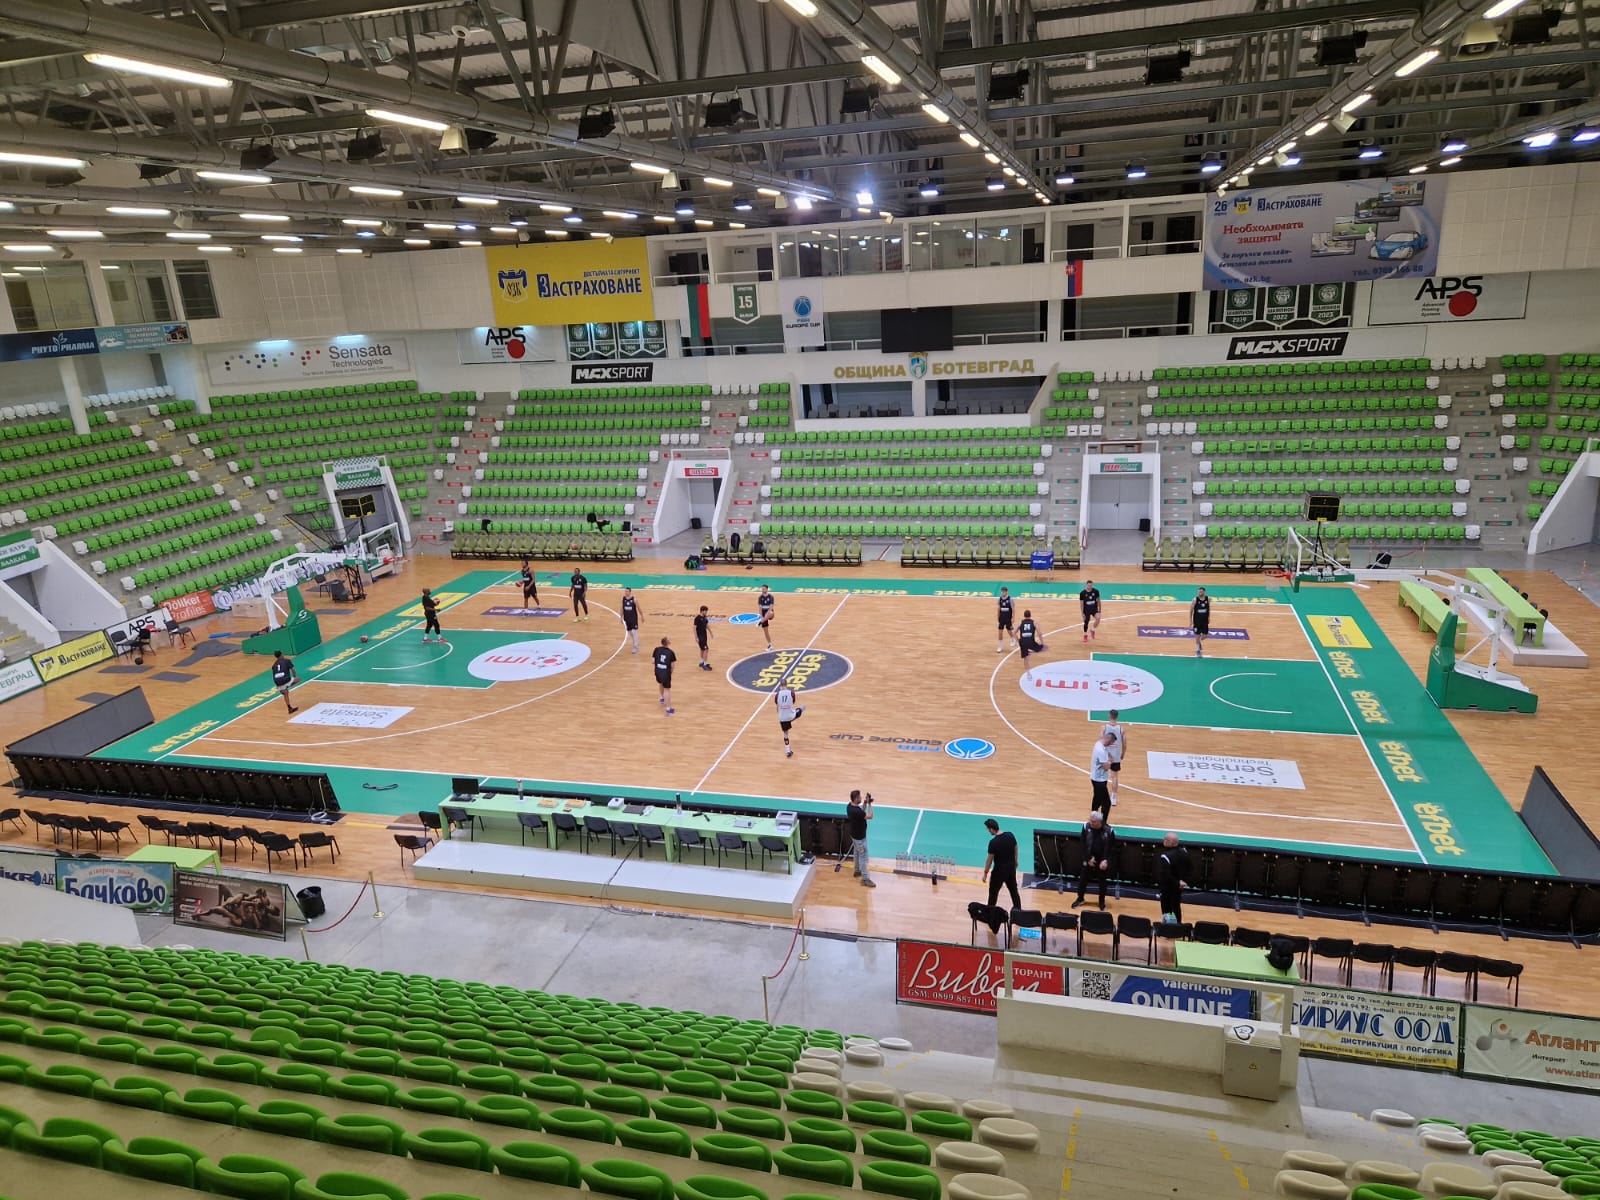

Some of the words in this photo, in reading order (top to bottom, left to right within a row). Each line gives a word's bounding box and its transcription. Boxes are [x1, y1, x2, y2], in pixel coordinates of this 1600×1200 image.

[1214, 201, 1228, 212] 26
[1223, 221, 1304, 234] Необходимата
[1238, 232, 1281, 244] защита!
[537, 274, 642, 298] ЗАСТРАХОВАНЕ
[1414, 276, 1482, 300] APS
[738, 296, 753, 308] 15
[485, 328, 526, 346] APS
[32, 346, 58, 354] PHYTO
[60, 342, 95, 352] PHARMA
[329, 344, 392, 360] Sensata
[1234, 338, 1342, 354] MAXSPORT
[332, 358, 384, 368] Technologies
[834, 364, 906, 379] ОБЩИНА
[932, 359, 1034, 376] БОТЕВГРАД
[576, 366, 649, 380] MAXSPORT
[128, 616, 156, 635] APS
[752, 650, 800, 688] efbet
[786, 653, 827, 690] efbet
[1352, 690, 1389, 724] efbet
[869, 736, 942, 746] EUROPE
[1172, 760, 1275, 776] Sensata
[1188, 756, 1270, 766] Technologies
[1378, 740, 1424, 782] efbet
[1413, 802, 1466, 856] efbet
[64, 877, 166, 904] Бачково
[932, 992, 954, 1000] 0899
[956, 995, 972, 1004] 887
[1131, 991, 1232, 1016] ONLINE
[1292, 1003, 1384, 1036] СИРИУС
[1394, 1016, 1454, 1045] ООД
[1340, 1037, 1398, 1050] ДИСТРИБУЦИЯ
[1532, 1054, 1566, 1063] Интернет
